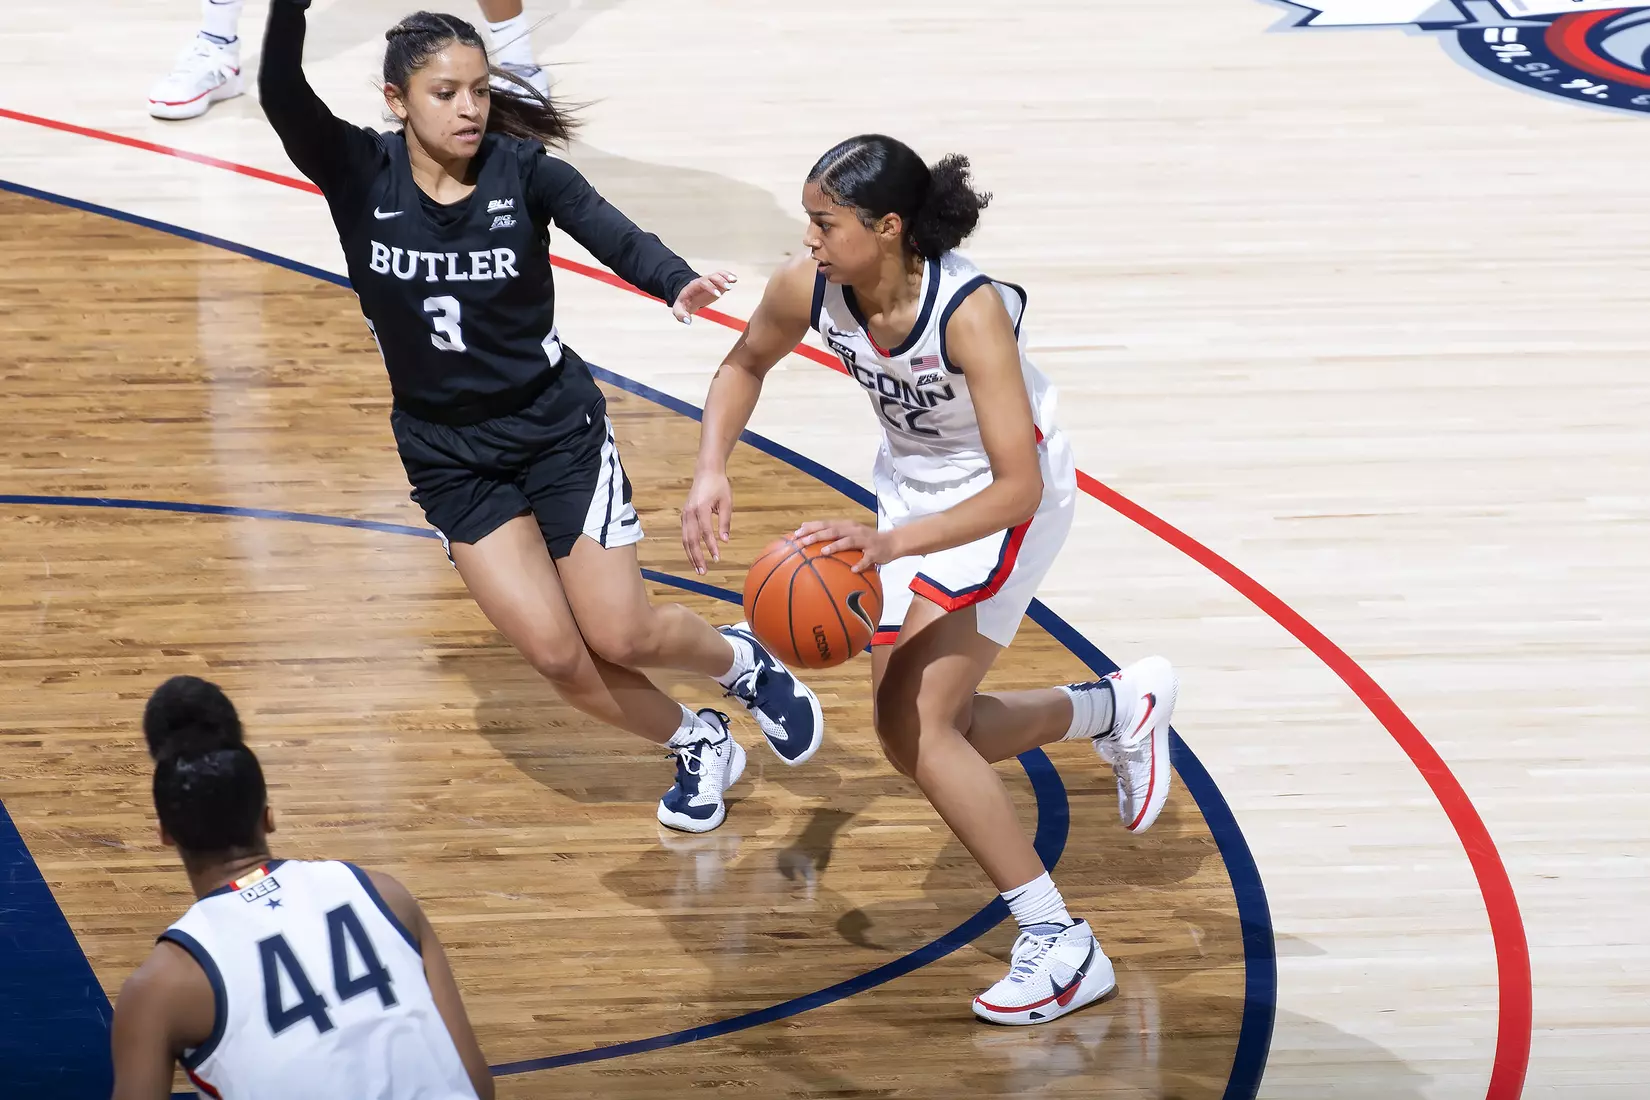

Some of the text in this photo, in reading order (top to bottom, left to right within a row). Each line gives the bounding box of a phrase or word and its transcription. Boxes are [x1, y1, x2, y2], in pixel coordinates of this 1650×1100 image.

[369, 240, 520, 282] BUTLER
[423, 295, 467, 352] 3
[240, 876, 281, 903] DEE
[257, 902, 400, 1038] 44
